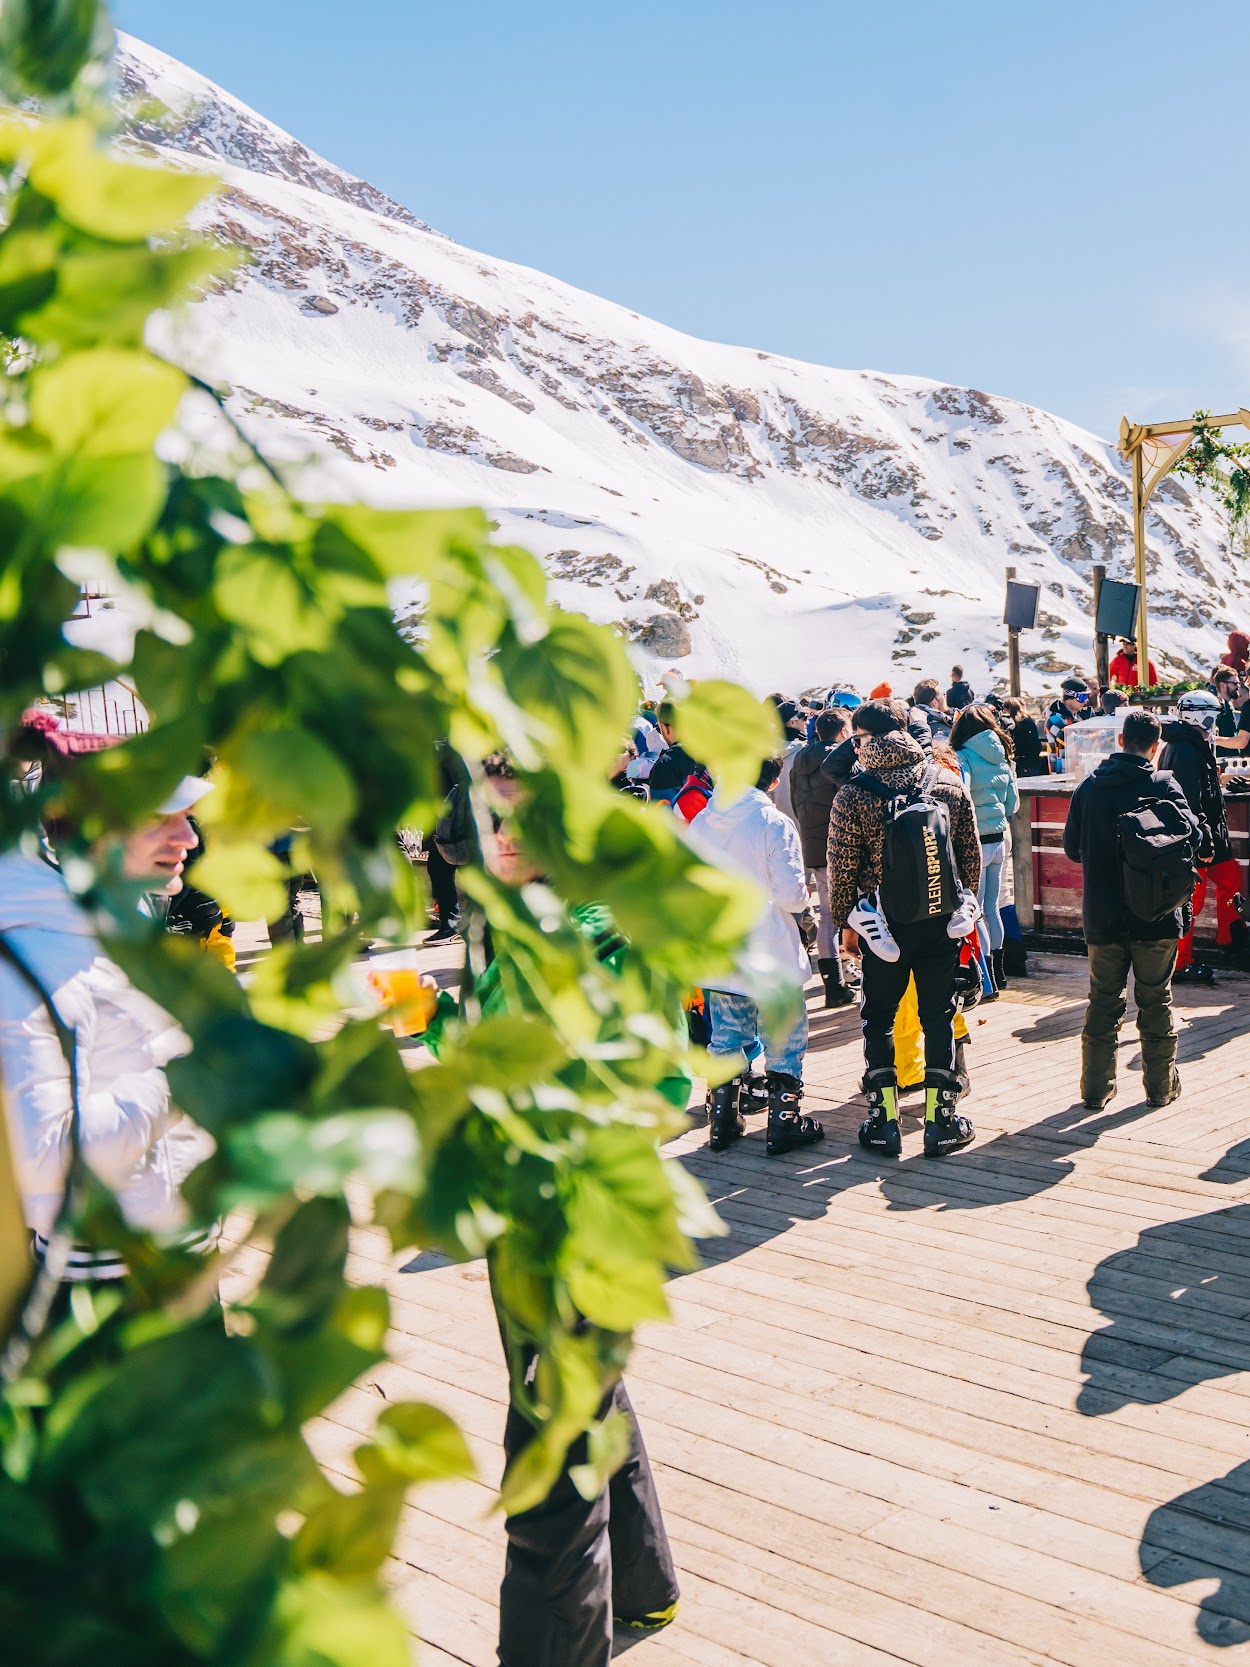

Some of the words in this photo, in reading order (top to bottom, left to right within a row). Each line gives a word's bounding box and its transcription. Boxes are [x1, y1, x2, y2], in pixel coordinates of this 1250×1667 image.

[922, 826, 941, 875] SPORT
[928, 875, 941, 915] PLEIN
[937, 1138, 957, 1146] HEAD
